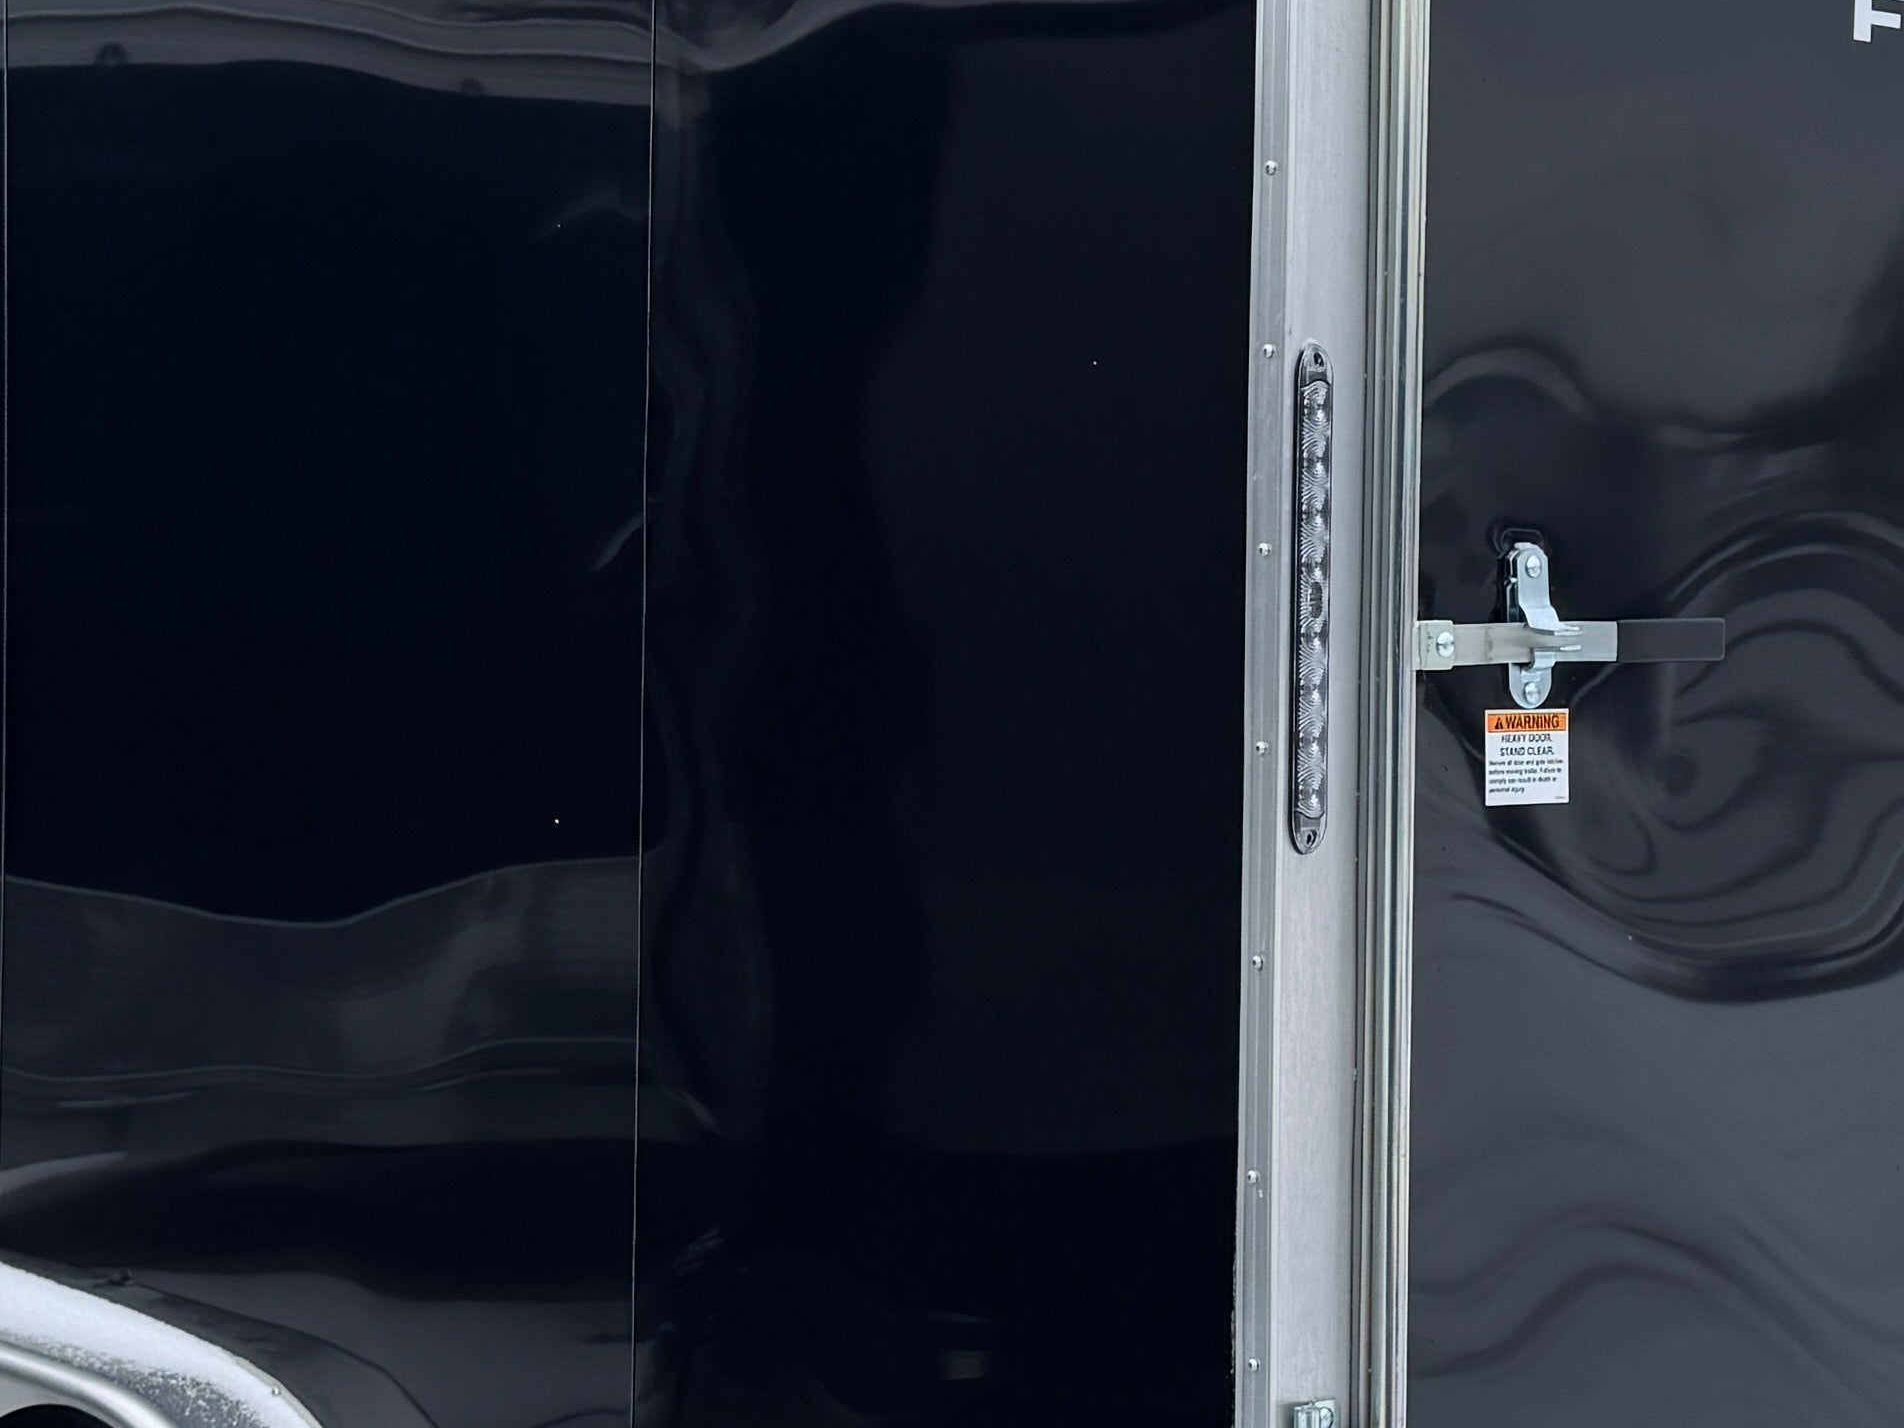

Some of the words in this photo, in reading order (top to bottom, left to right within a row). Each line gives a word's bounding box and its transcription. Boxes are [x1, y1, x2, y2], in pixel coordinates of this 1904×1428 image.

[1505, 714, 1560, 729] WARNING
[1501, 734, 1527, 743] HEAVY
[1528, 733, 1553, 743] DOOR
[1500, 746, 1526, 756] STAND
[1527, 746, 1554, 756] CLEAR
